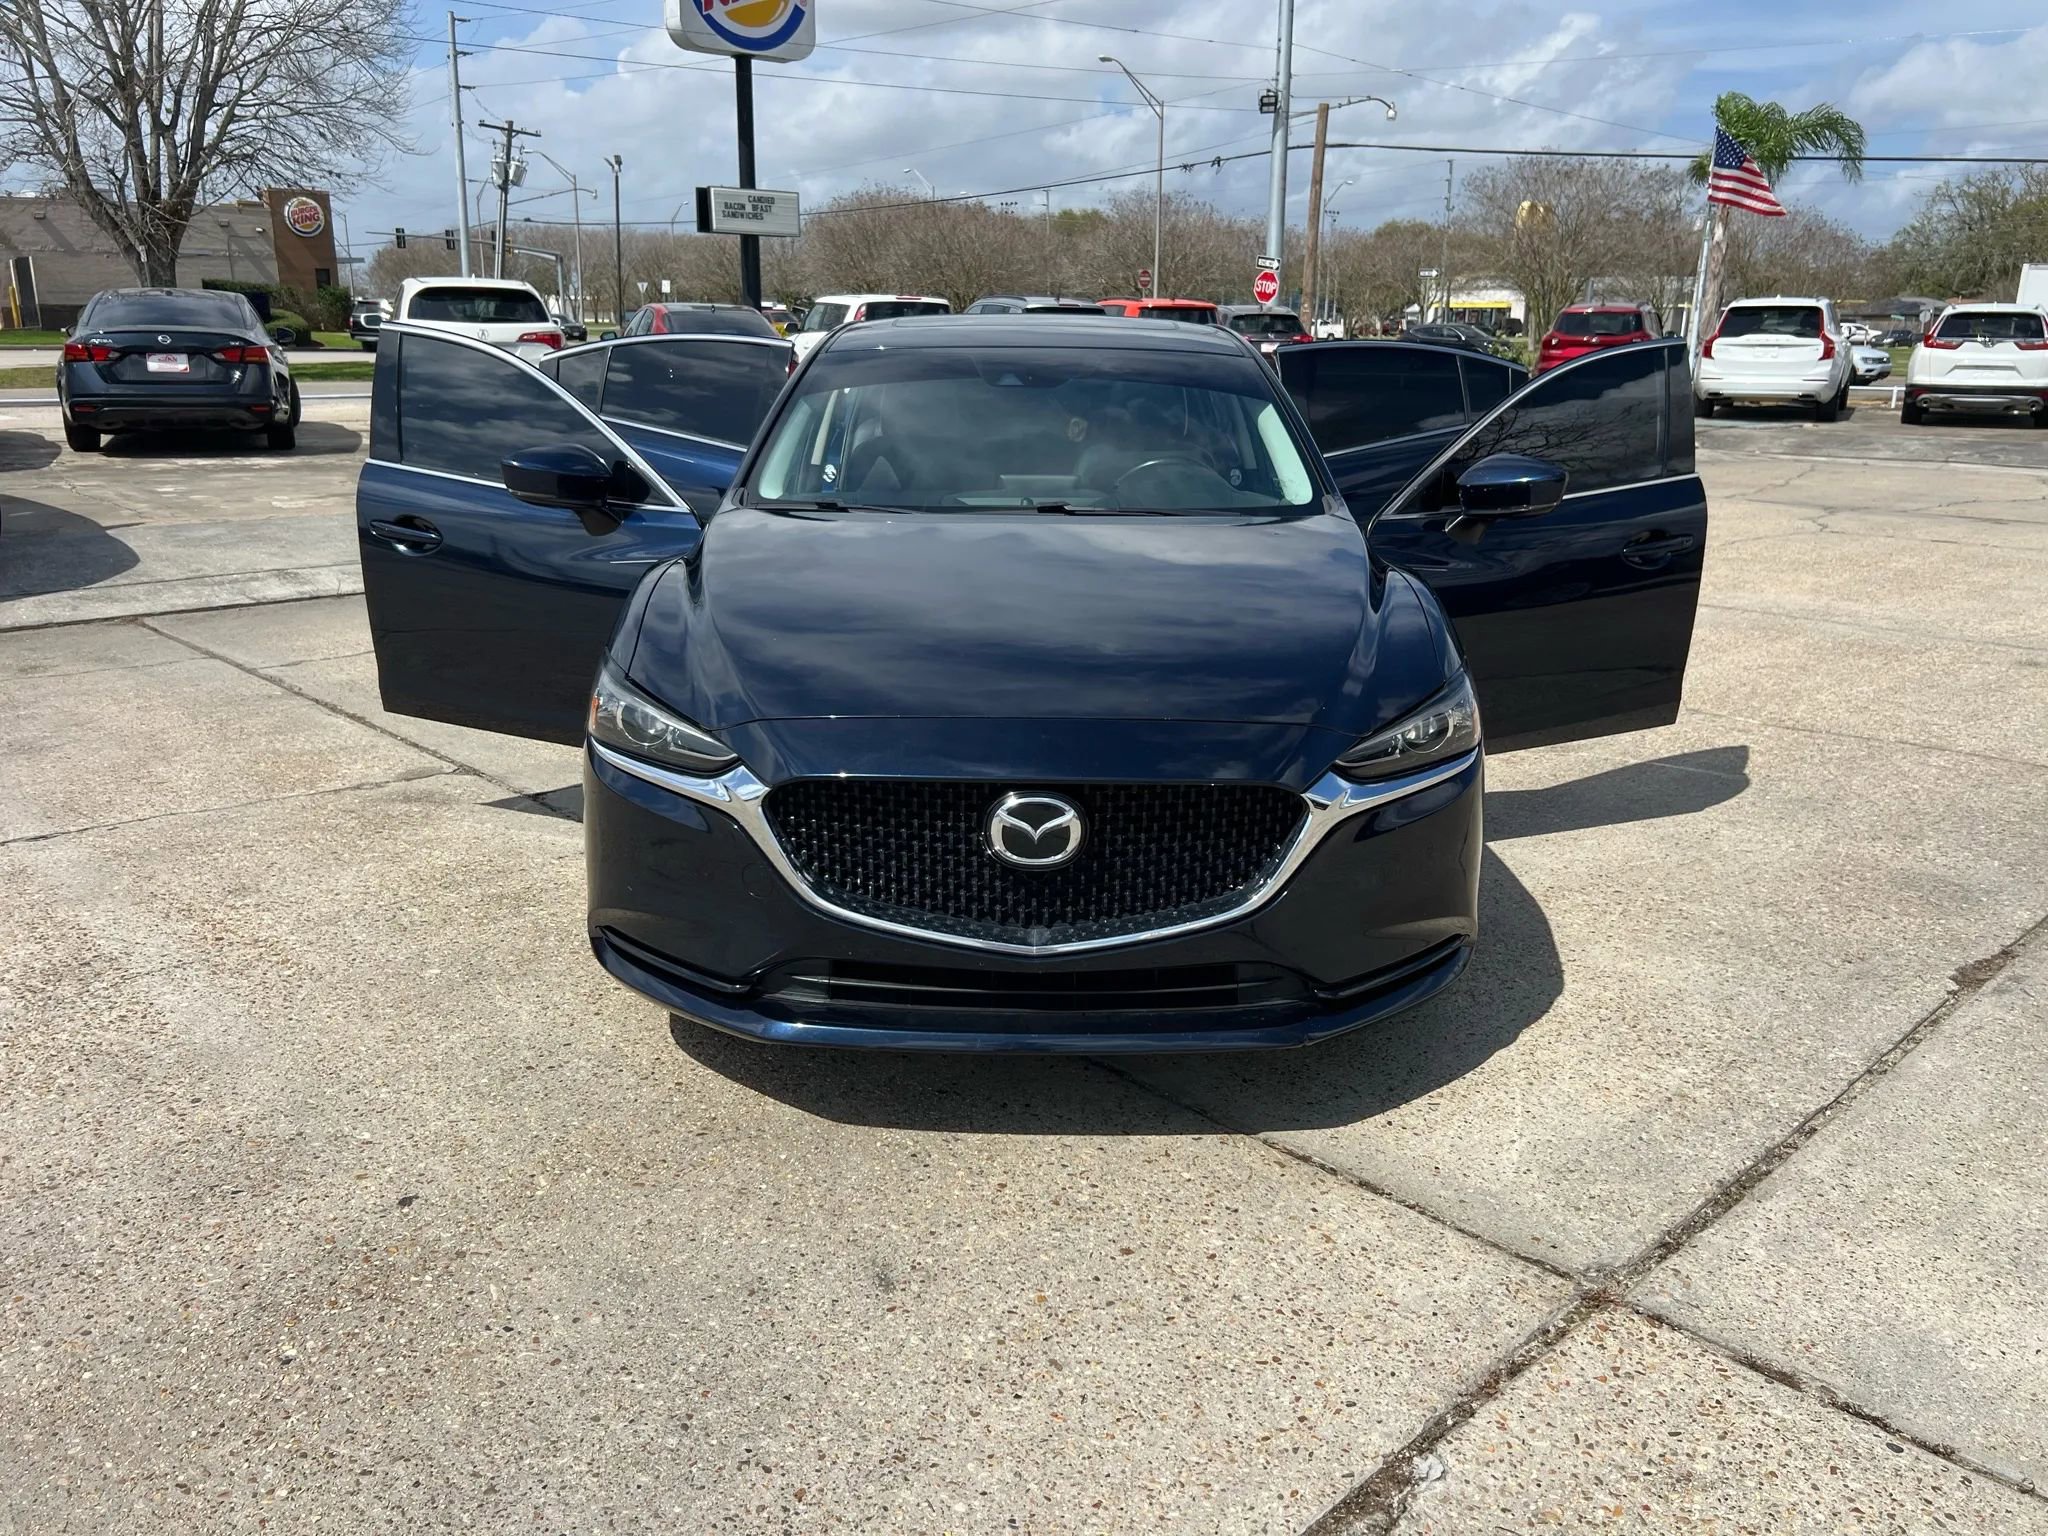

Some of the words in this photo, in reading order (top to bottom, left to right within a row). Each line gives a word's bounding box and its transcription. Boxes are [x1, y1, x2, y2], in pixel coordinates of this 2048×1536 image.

[291, 206, 318, 216] BURGER
[724, 202, 746, 211] BACON
[751, 204, 772, 212] BFAST
[293, 212, 320, 226] KING
[722, 210, 764, 220] SANDWICHES
[1256, 280, 1277, 294] STOP
